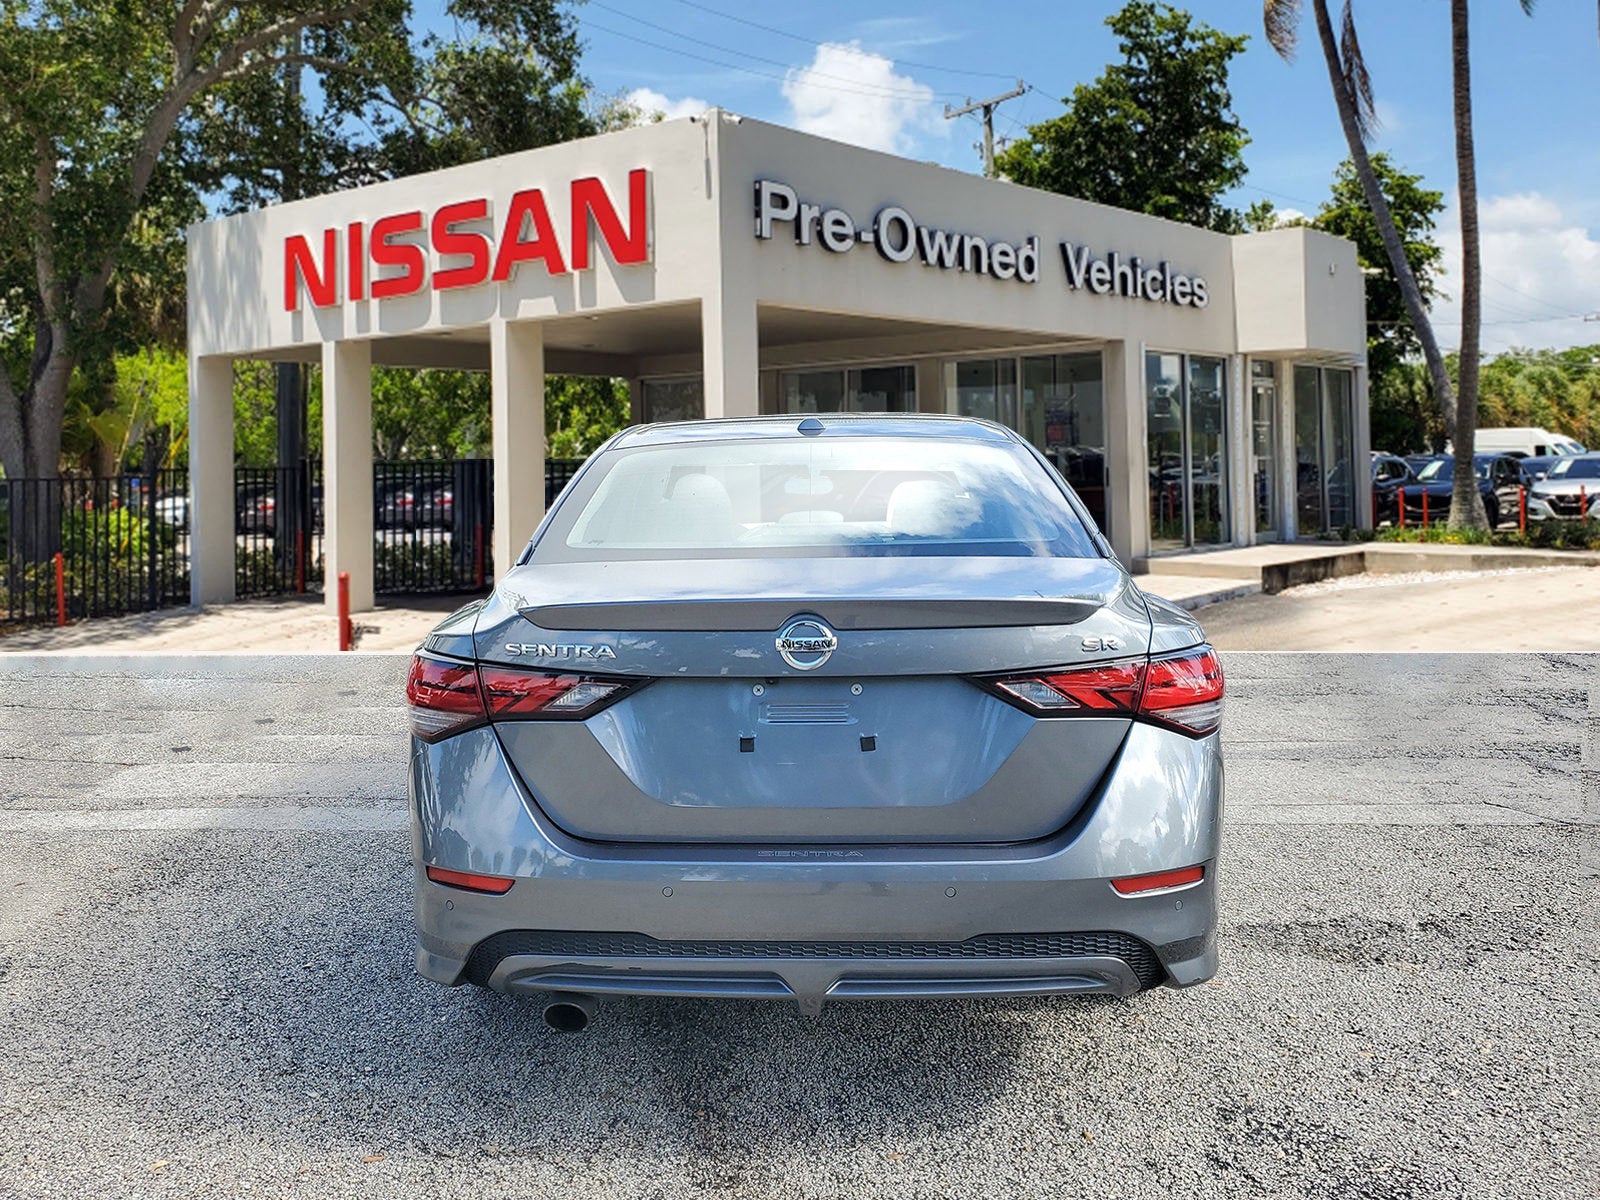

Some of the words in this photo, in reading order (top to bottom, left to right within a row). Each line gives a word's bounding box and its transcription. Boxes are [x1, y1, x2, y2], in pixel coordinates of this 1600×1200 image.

[284, 168, 647, 312] NISSAN
[754, 179, 1040, 284] Pre-Owned
[1060, 241, 1209, 309] Vehicles
[504, 642, 617, 660] SENTRA
[781, 639, 833, 650] NISSAN
[1081, 637, 1119, 653] SR
[757, 849, 864, 857] SENTRA
